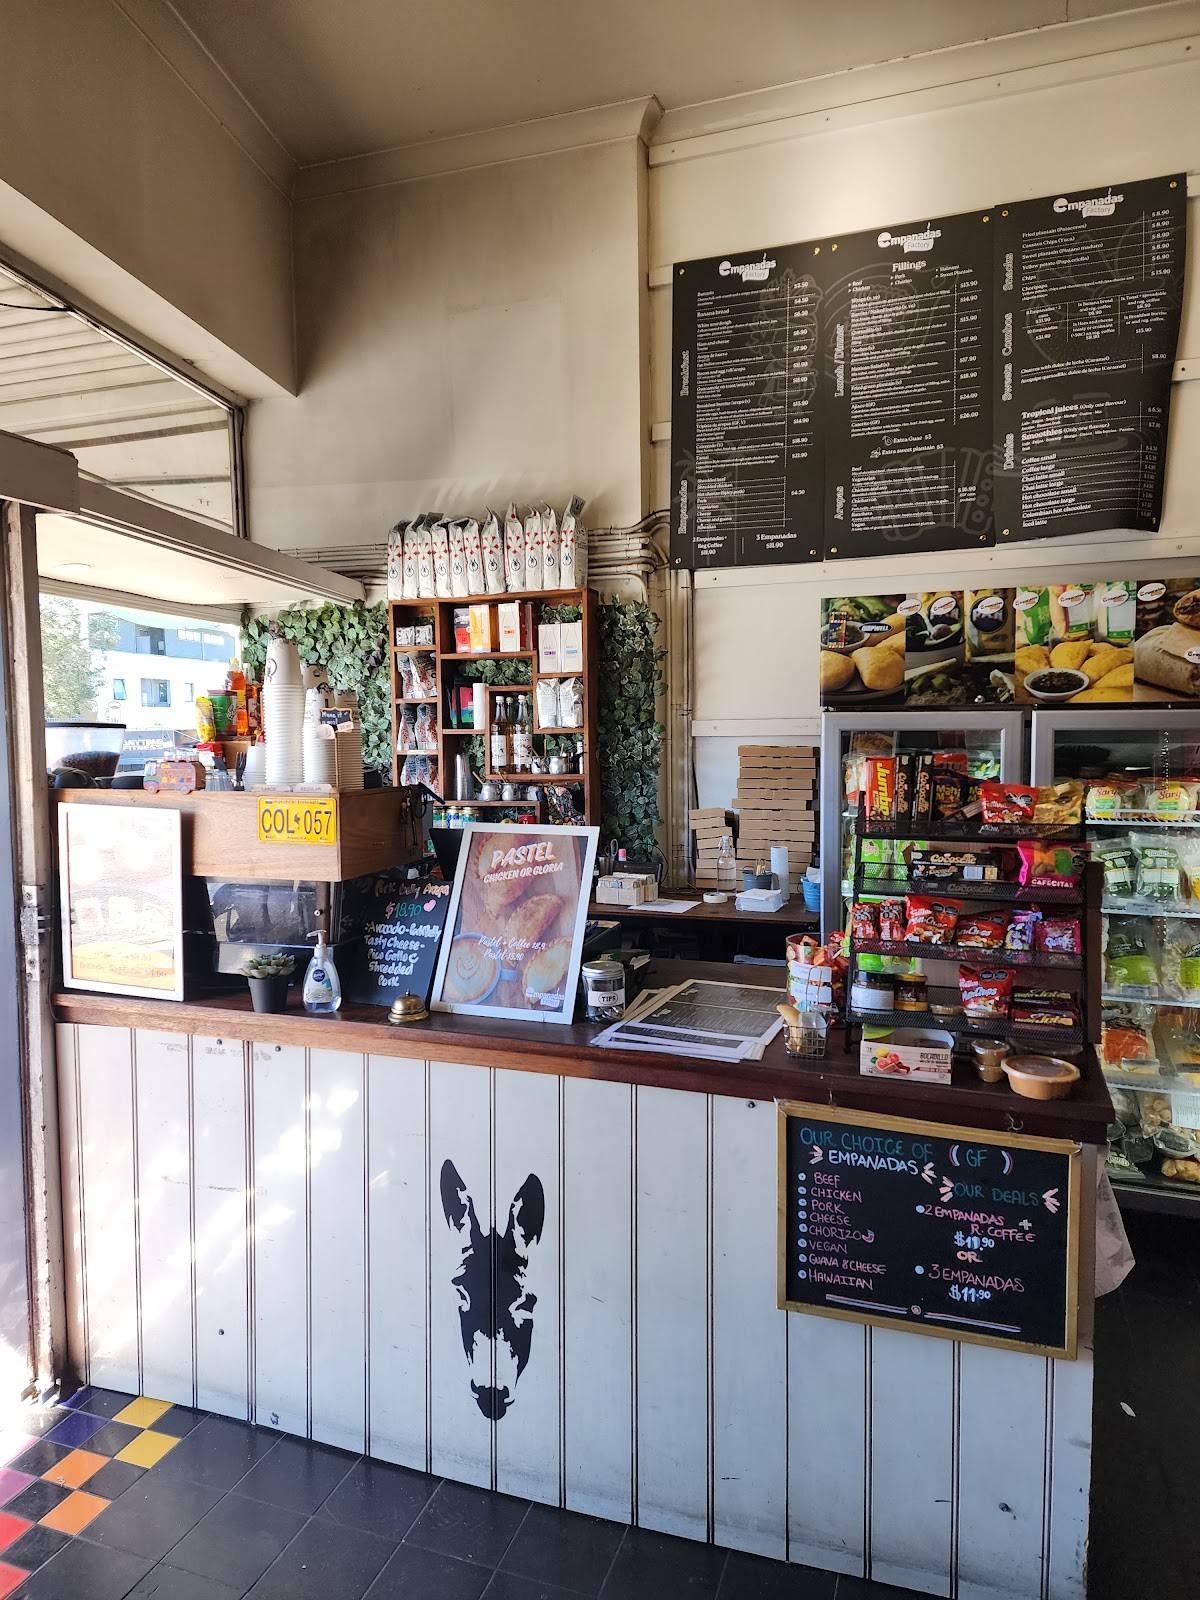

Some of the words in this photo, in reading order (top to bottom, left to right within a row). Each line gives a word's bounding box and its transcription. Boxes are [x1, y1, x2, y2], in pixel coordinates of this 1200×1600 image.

[1036, 229, 1056, 237] plantain
[892, 260, 926, 272] Fillings
[715, 308, 730, 316] bread
[834, 323, 845, 359] Dinner
[1022, 407, 1054, 418] Tropical
[1055, 404, 1078, 414] juices
[1022, 429, 1062, 441] Smoothies
[913, 445, 935, 453] plantain
[1041, 453, 1056, 461] small
[1041, 464, 1055, 472] large
[1049, 470, 1065, 478] small
[1049, 480, 1064, 488] large
[1034, 490, 1061, 498] chocolate
[678, 480, 689, 534] Empanadas
[1034, 499, 1060, 507] chocolate
[1022, 510, 1052, 518] Colombian
[1063, 504, 1091, 512] chocolate
[761, 532, 797, 541] Empanadas
[876, 762, 893, 816] Jumbo
[1159, 789, 1182, 800] Sary
[261, 808, 295, 834] COL
[304, 810, 332, 835] 057
[491, 842, 557, 869] PASTEL
[484, 870, 518, 883] CHICKEN
[520, 867, 532, 877] OR
[533, 862, 563, 876] GLORIA
[385, 901, 422, 919] $18.90
[364, 935, 387, 949] Tasty
[479, 936, 501, 947] Pastel
[508, 936, 530, 948] Coffee
[483, 949, 505, 960] Pastel
[369, 960, 413, 975] Shredded
[800, 1127, 833, 1146] OUR
[841, 1132, 904, 1155] CHOICE
[912, 1143, 933, 1162] OF
[966, 1150, 988, 1167] GF
[828, 1150, 919, 1175] EMPANADAS
[814, 1172, 840, 1188] BEEF
[810, 1187, 862, 1203] CHICKEN
[954, 1183, 984, 1198] OUR
[992, 1188, 1039, 1206] DEALS
[811, 1200, 845, 1214] PORK
[809, 1212, 851, 1226] CHEESE
[925, 1205, 933, 1216] 2
[934, 1206, 1005, 1226] EMPANADAS
[808, 1225, 862, 1240] CHORIZO
[970, 1224, 984, 1235] R.
[988, 1227, 1036, 1242] COFFEE
[808, 1240, 848, 1254] VEGAN
[808, 1253, 839, 1268] GUAVA
[956, 1251, 983, 1263] OR
[808, 1268, 873, 1290] HAWAIIAN
[928, 1263, 941, 1279] 3
[942, 1268, 1025, 1292] EMPANADAS
